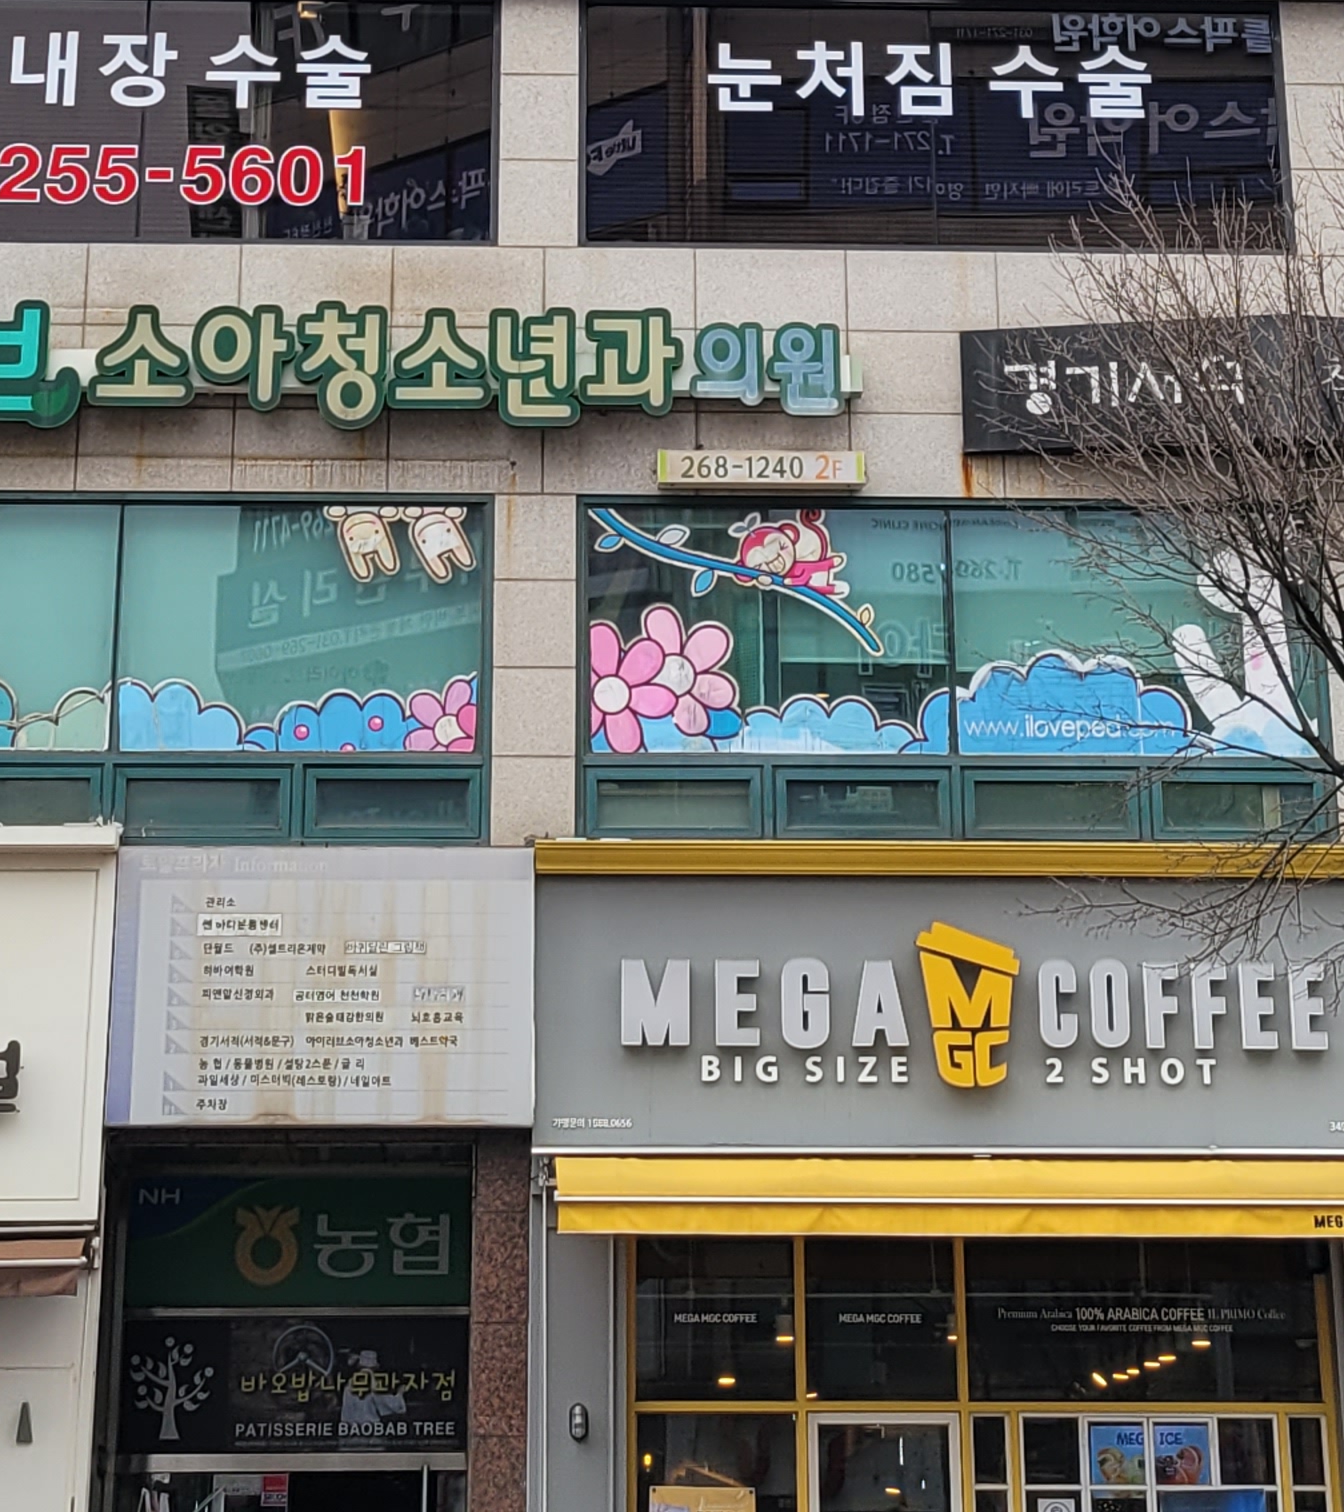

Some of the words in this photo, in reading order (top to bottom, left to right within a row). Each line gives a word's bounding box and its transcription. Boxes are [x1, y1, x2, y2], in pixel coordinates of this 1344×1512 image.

[202, 29, 375, 113] 수술
[705, 39, 956, 119] 눈처짐
[987, 43, 1154, 122] 수술
[690, 322, 851, 417] 의원
[680, 453, 805, 482] 268-1240
[814, 453, 845, 482] 2F
[205, 896, 236, 909] 관리소
[620, 957, 910, 1050] MEGA
[1036, 957, 1330, 1053] COFFEE
[700, 1054, 780, 1085] BIG
[803, 1055, 910, 1084] SIZE
[1044, 1058, 1065, 1084] 2
[1091, 1057, 1218, 1086] SHOT
[139, 1186, 182, 1206] NH
[312, 1211, 452, 1279] 농협
[1075, 1307, 1105, 1321] 100%
[1106, 1307, 1159, 1322] ARABICA
[1160, 1307, 1205, 1322] COFFEE
[235, 1421, 333, 1438] PATISSERIE
[337, 1420, 408, 1438] BAOBAB
[412, 1420, 456, 1437] TREE
[1158, 1431, 1183, 1446] ICE
